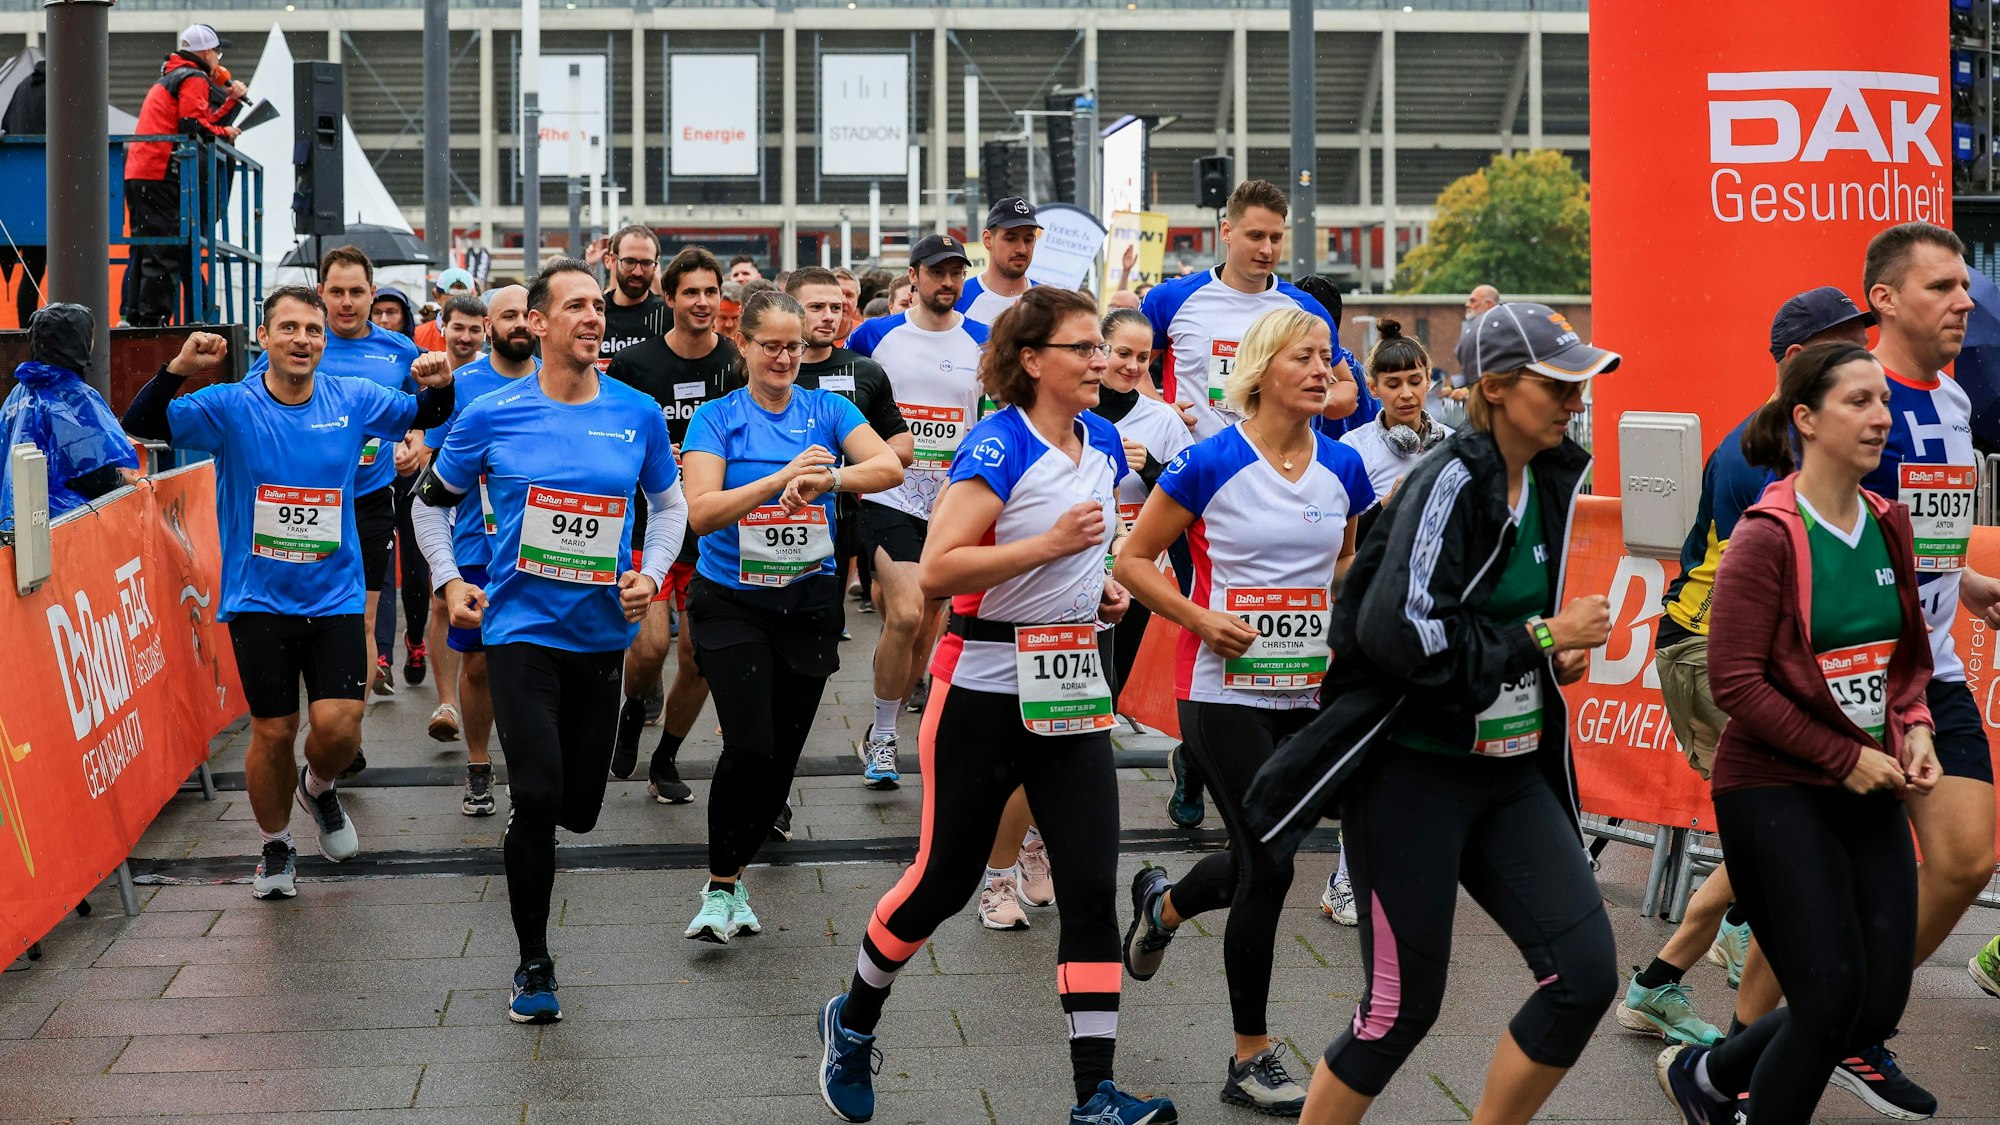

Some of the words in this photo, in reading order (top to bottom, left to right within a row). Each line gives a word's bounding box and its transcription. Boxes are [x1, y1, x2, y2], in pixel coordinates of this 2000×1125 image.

[1708, 70, 1943, 167] DAK
[540, 127, 587, 141] Rhen
[682, 127, 746, 144] Energie
[829, 126, 901, 141] STADION
[1710, 168, 1945, 224] Gesundheit
[600, 336, 647, 354] eloi
[663, 400, 706, 420] eloi
[588, 430, 625, 440] bank-verlag
[910, 421, 956, 439] 0609
[979, 445, 999, 460] LYB
[1628, 475, 1665, 493] RFID
[1908, 471, 1934, 481] B2Run
[536, 493, 562, 504] B2Run
[1910, 492, 1971, 517] 15037
[279, 506, 319, 525] 952
[552, 514, 599, 539] 949
[1935, 521, 1954, 529] ANTON
[560, 538, 586, 547] MARIO
[765, 526, 808, 547] 963
[542, 553, 571, 563] STARTZEIT
[572, 557, 587, 565] 16:30
[115, 556, 154, 641] DAK
[1235, 594, 1264, 603] B2Run
[1027, 633, 1059, 643] B2Run
[1261, 641, 1305, 649] CHRISTINA
[1822, 657, 1852, 670] B2Run
[1966, 618, 1986, 695] wered
[1033, 653, 1098, 680] 10741
[1050, 705, 1077, 713] STARTZEIT
